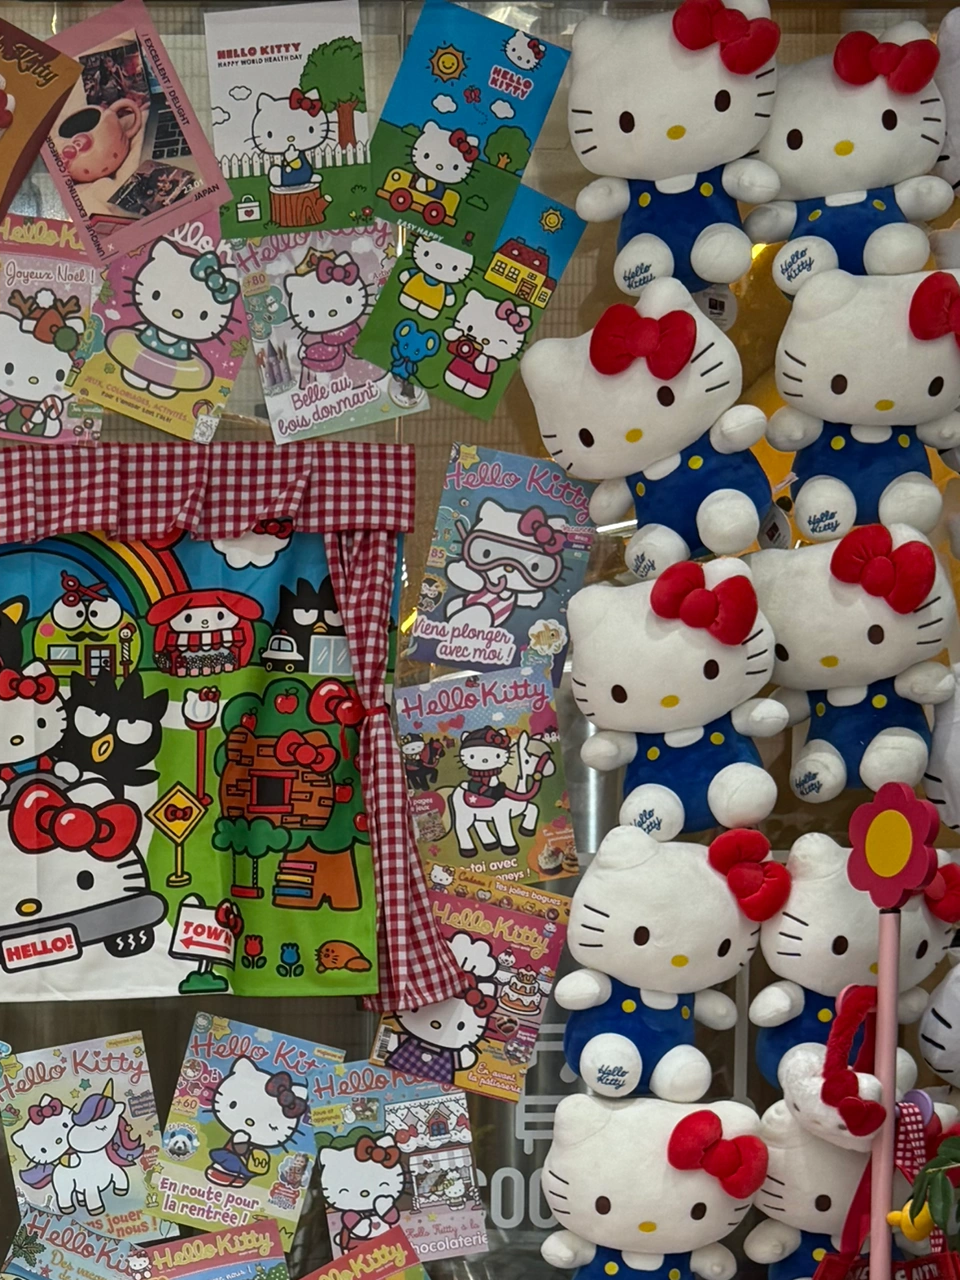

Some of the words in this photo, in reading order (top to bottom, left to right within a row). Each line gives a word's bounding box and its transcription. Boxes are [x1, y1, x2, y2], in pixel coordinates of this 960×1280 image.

[217, 46, 258, 60] HELLO
[260, 42, 302, 56] KITTY
[217, 59, 240, 68] HAPPY
[240, 57, 263, 67] WORLD
[264, 55, 288, 65] HEALTH
[288, 53, 304, 62] DAY
[3, 42, 60, 88] Kitty
[492, 65, 533, 90] HELLO
[489, 77, 531, 100] KITTY
[193, 184, 220, 202] JAPAN
[5, 261, 53, 288] Joyeux
[55, 263, 86, 283] Noël
[623, 262, 653, 283] Hello
[780, 247, 810, 276] Hello
[786, 257, 816, 284] Kitty
[245, 273, 267, 288] +80
[627, 272, 657, 291] Kitty
[291, 383, 330, 412] Belle
[331, 377, 353, 399] au
[277, 411, 311, 437] bois
[312, 385, 380, 422] dormant
[444, 461, 522, 491] Hello
[525, 464, 592, 524] Kitty
[807, 509, 839, 528] Hello
[810, 517, 842, 536] Kitty
[413, 614, 449, 638] Viens
[449, 622, 512, 651] plonger
[439, 641, 471, 659] avec
[471, 647, 504, 661] moi
[401, 684, 481, 721] Hello
[480, 676, 550, 713] Kitty
[490, 857, 519, 873] avec
[182, 920, 232, 946] TOWN
[432, 900, 493, 935] Hello
[493, 913, 550, 960] Kitty
[4, 933, 73, 962] HELLO!
[191, 1032, 270, 1062] Hello
[72, 1049, 151, 1086] Kitty
[596, 1064, 630, 1079] Hello
[312, 1066, 390, 1101] Hello
[596, 1074, 627, 1091] Kitty
[176, 1099, 198, 1111] +60
[160, 1177, 181, 1191] En
[181, 1182, 226, 1202] route
[226, 1193, 260, 1213] pour
[163, 1194, 181, 1213] la
[180, 1200, 240, 1226] rentrée
[26, 1214, 98, 1263] Hello
[152, 1237, 217, 1270] Hello
[216, 1230, 274, 1257] Kitty
[352, 1243, 408, 1278] Kitty
